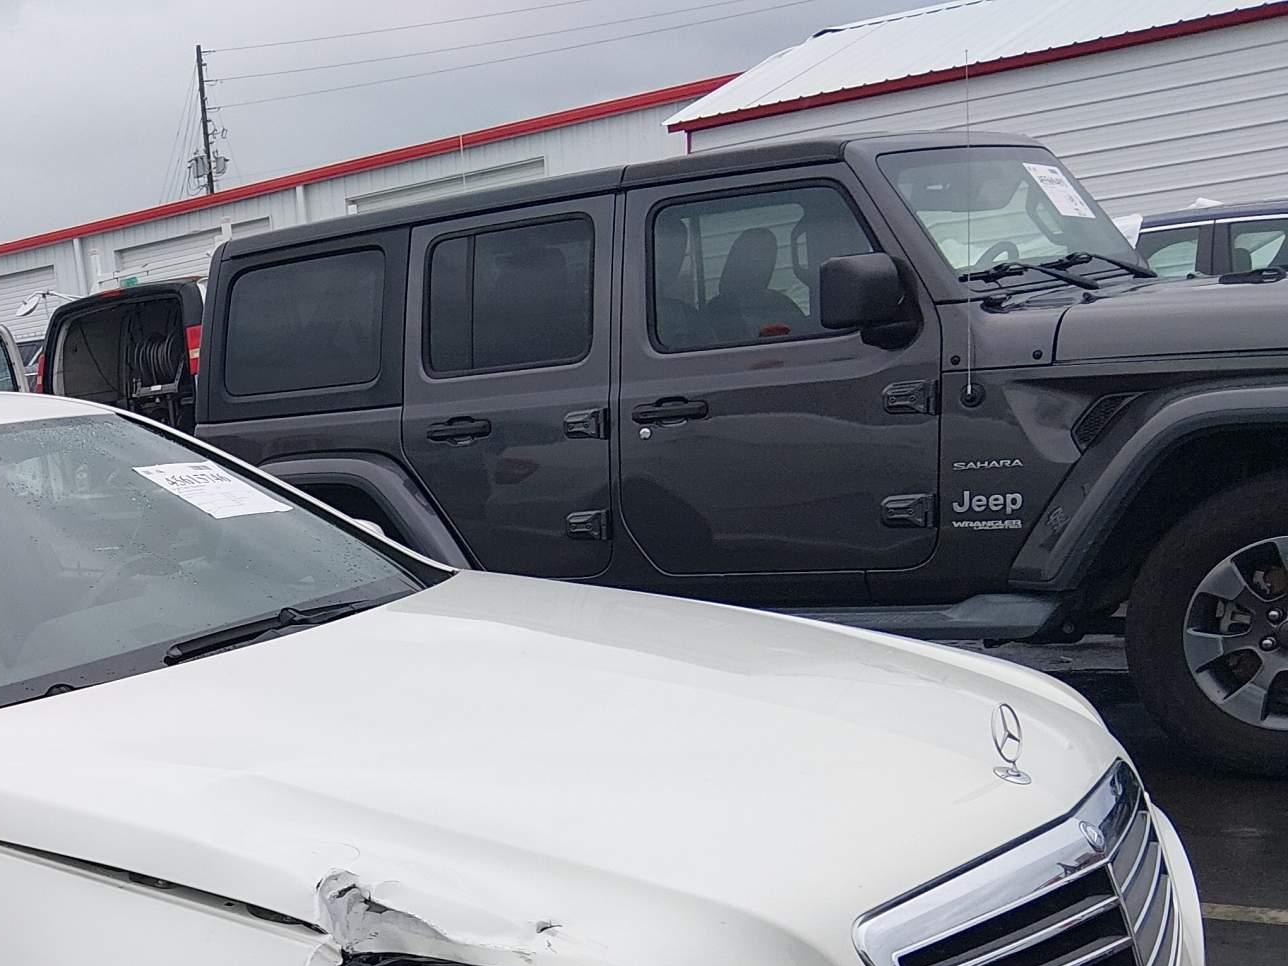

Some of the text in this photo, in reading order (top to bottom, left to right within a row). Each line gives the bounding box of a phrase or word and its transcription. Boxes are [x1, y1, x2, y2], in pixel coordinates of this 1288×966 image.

[953, 459, 1023, 470] SAHARA
[952, 490, 1023, 515] Jeep
[952, 519, 1022, 529] WRANGLER
